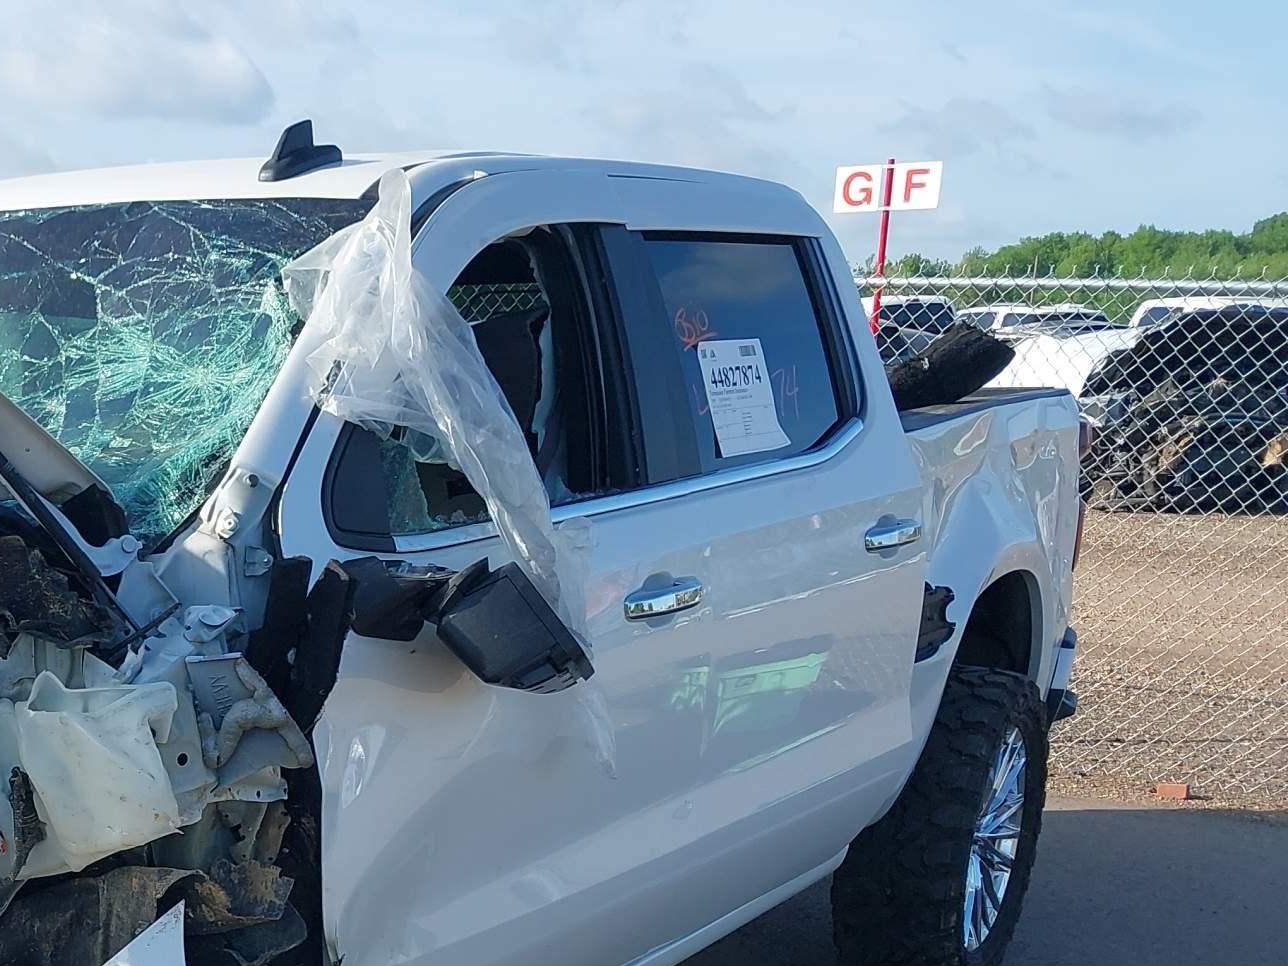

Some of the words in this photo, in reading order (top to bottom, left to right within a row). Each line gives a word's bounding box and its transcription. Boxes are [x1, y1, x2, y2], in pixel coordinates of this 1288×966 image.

[842, 171, 872, 206] G
[905, 168, 930, 203] F
[711, 364, 761, 388] 44827874
